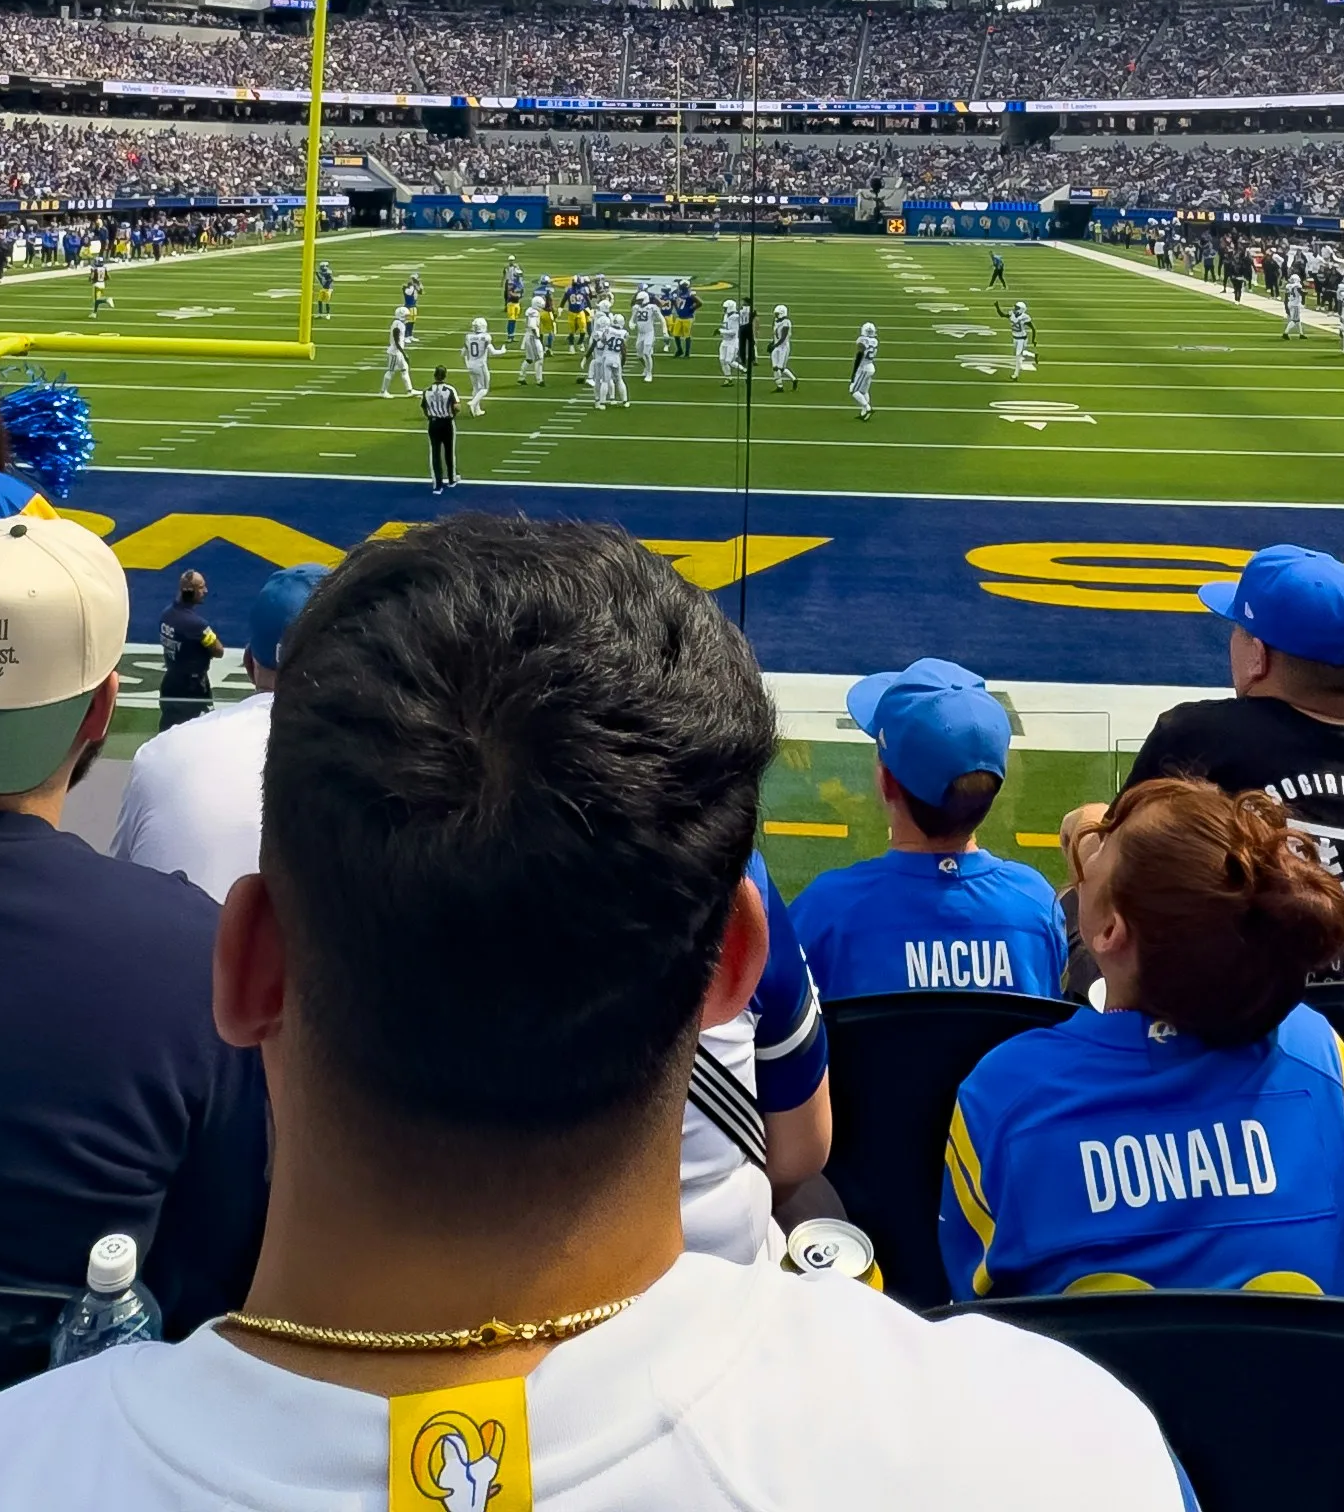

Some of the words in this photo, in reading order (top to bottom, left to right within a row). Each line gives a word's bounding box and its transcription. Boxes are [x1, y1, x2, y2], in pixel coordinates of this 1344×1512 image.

[554, 215, 579, 227] 8:14
[889, 219, 904, 233] 25
[471, 342, 478, 357] 0
[904, 939, 1014, 990] NACUA
[1079, 1118, 1277, 1215] DONALD
